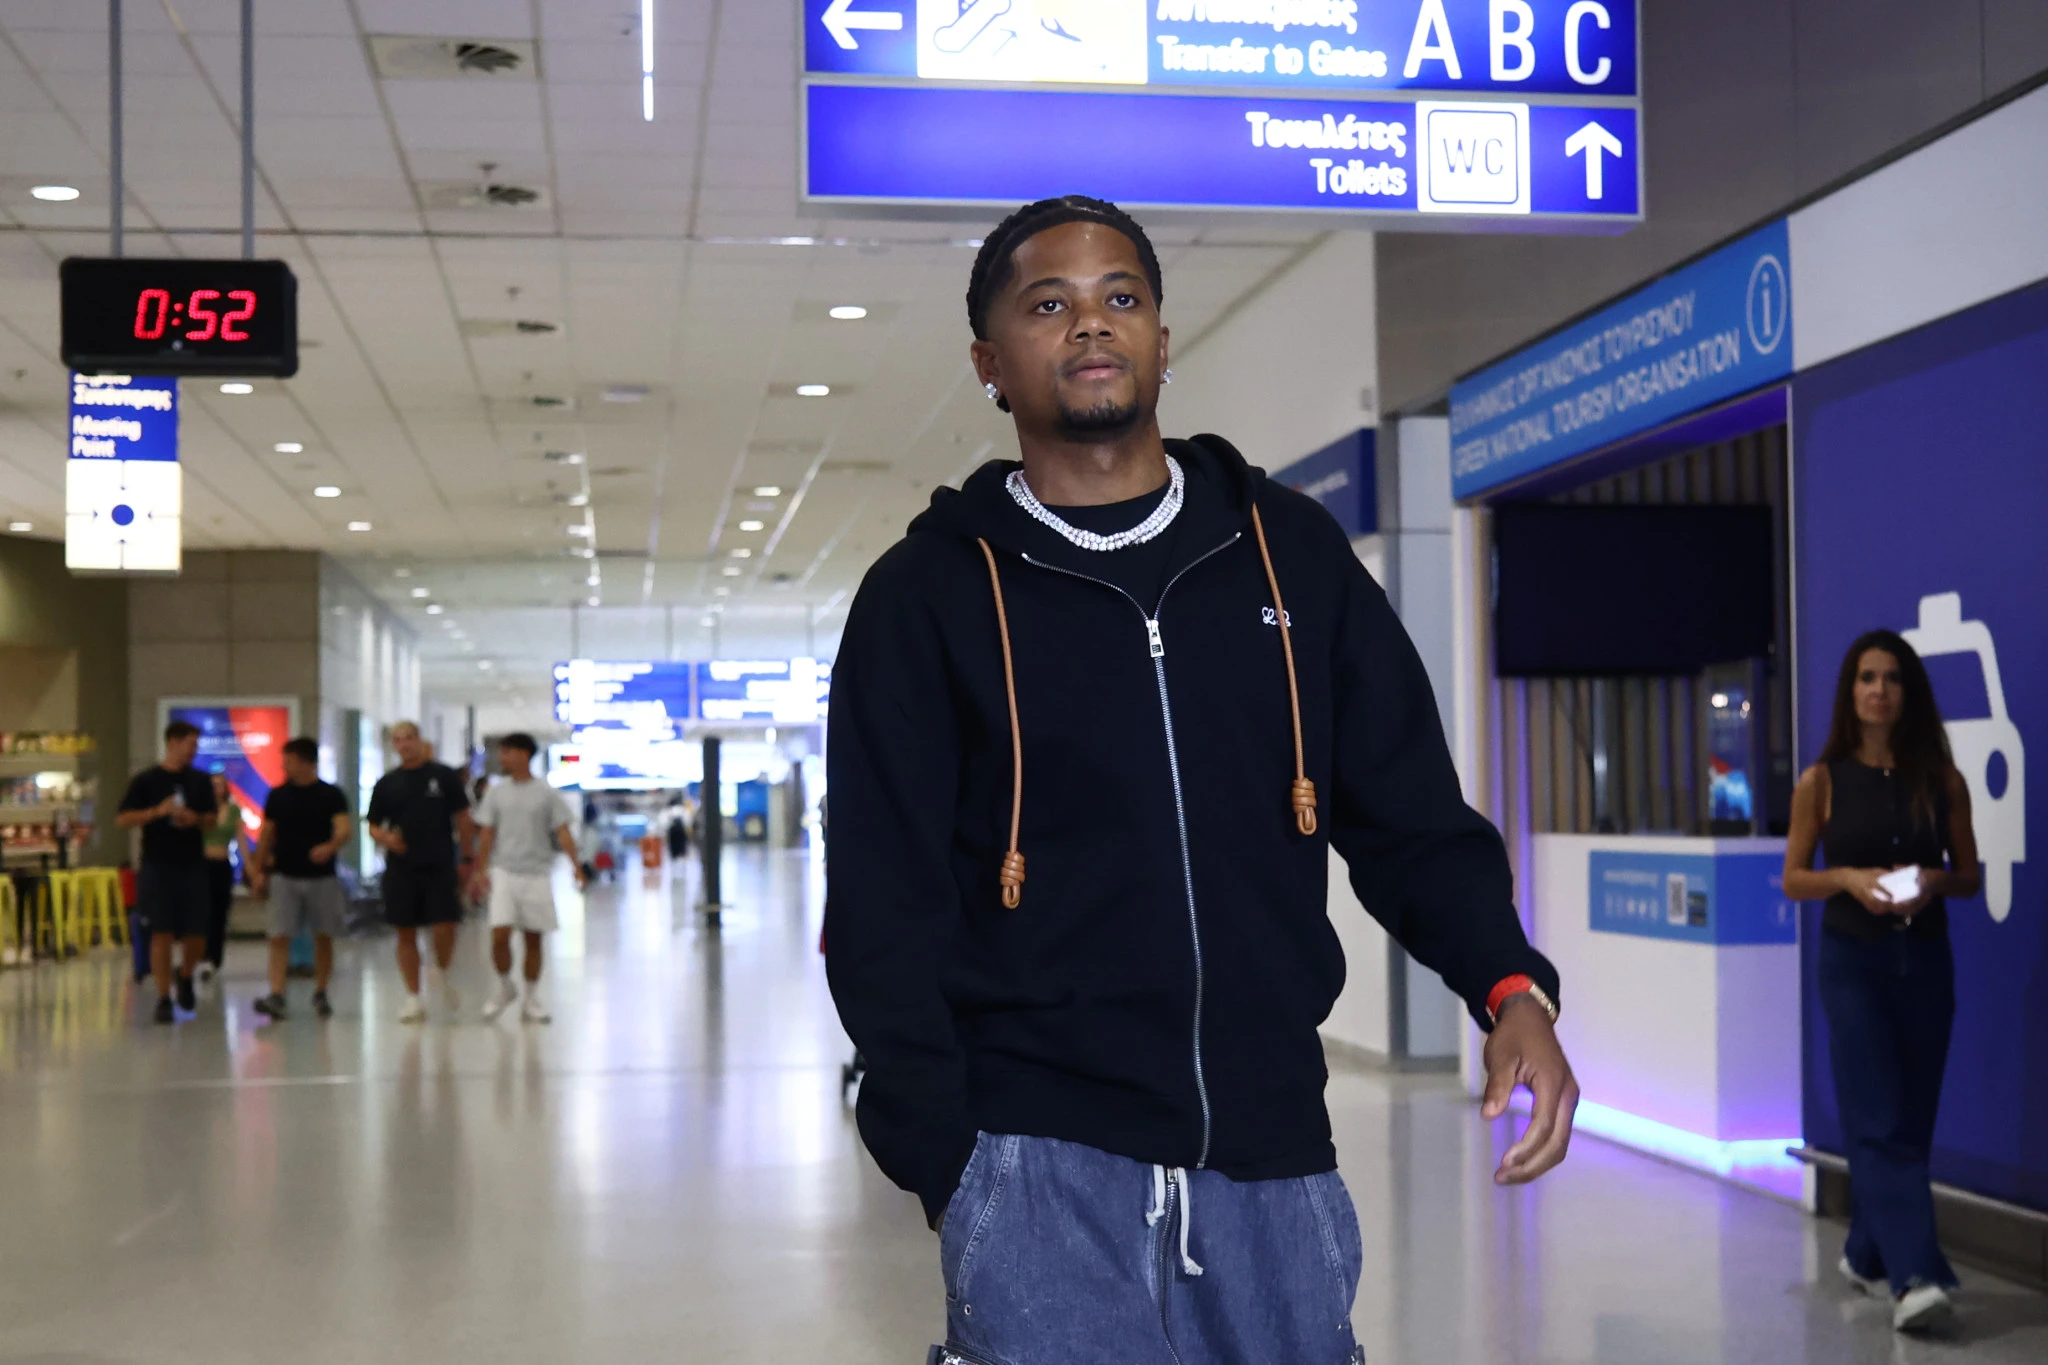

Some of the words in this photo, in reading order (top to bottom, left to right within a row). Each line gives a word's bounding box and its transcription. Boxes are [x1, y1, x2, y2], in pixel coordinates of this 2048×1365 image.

[1156, 35, 1270, 73] Transfer
[1272, 43, 1304, 75] to
[1308, 40, 1388, 78] Gates
[1403, 0, 1463, 79] A
[1489, 0, 1536, 82] B
[1564, 0, 1612, 85] C
[1309, 158, 1408, 196] Toilets
[1442, 137, 1504, 175] WC
[134, 288, 256, 341] 0:52
[1615, 327, 1741, 412] ORGANISATION
